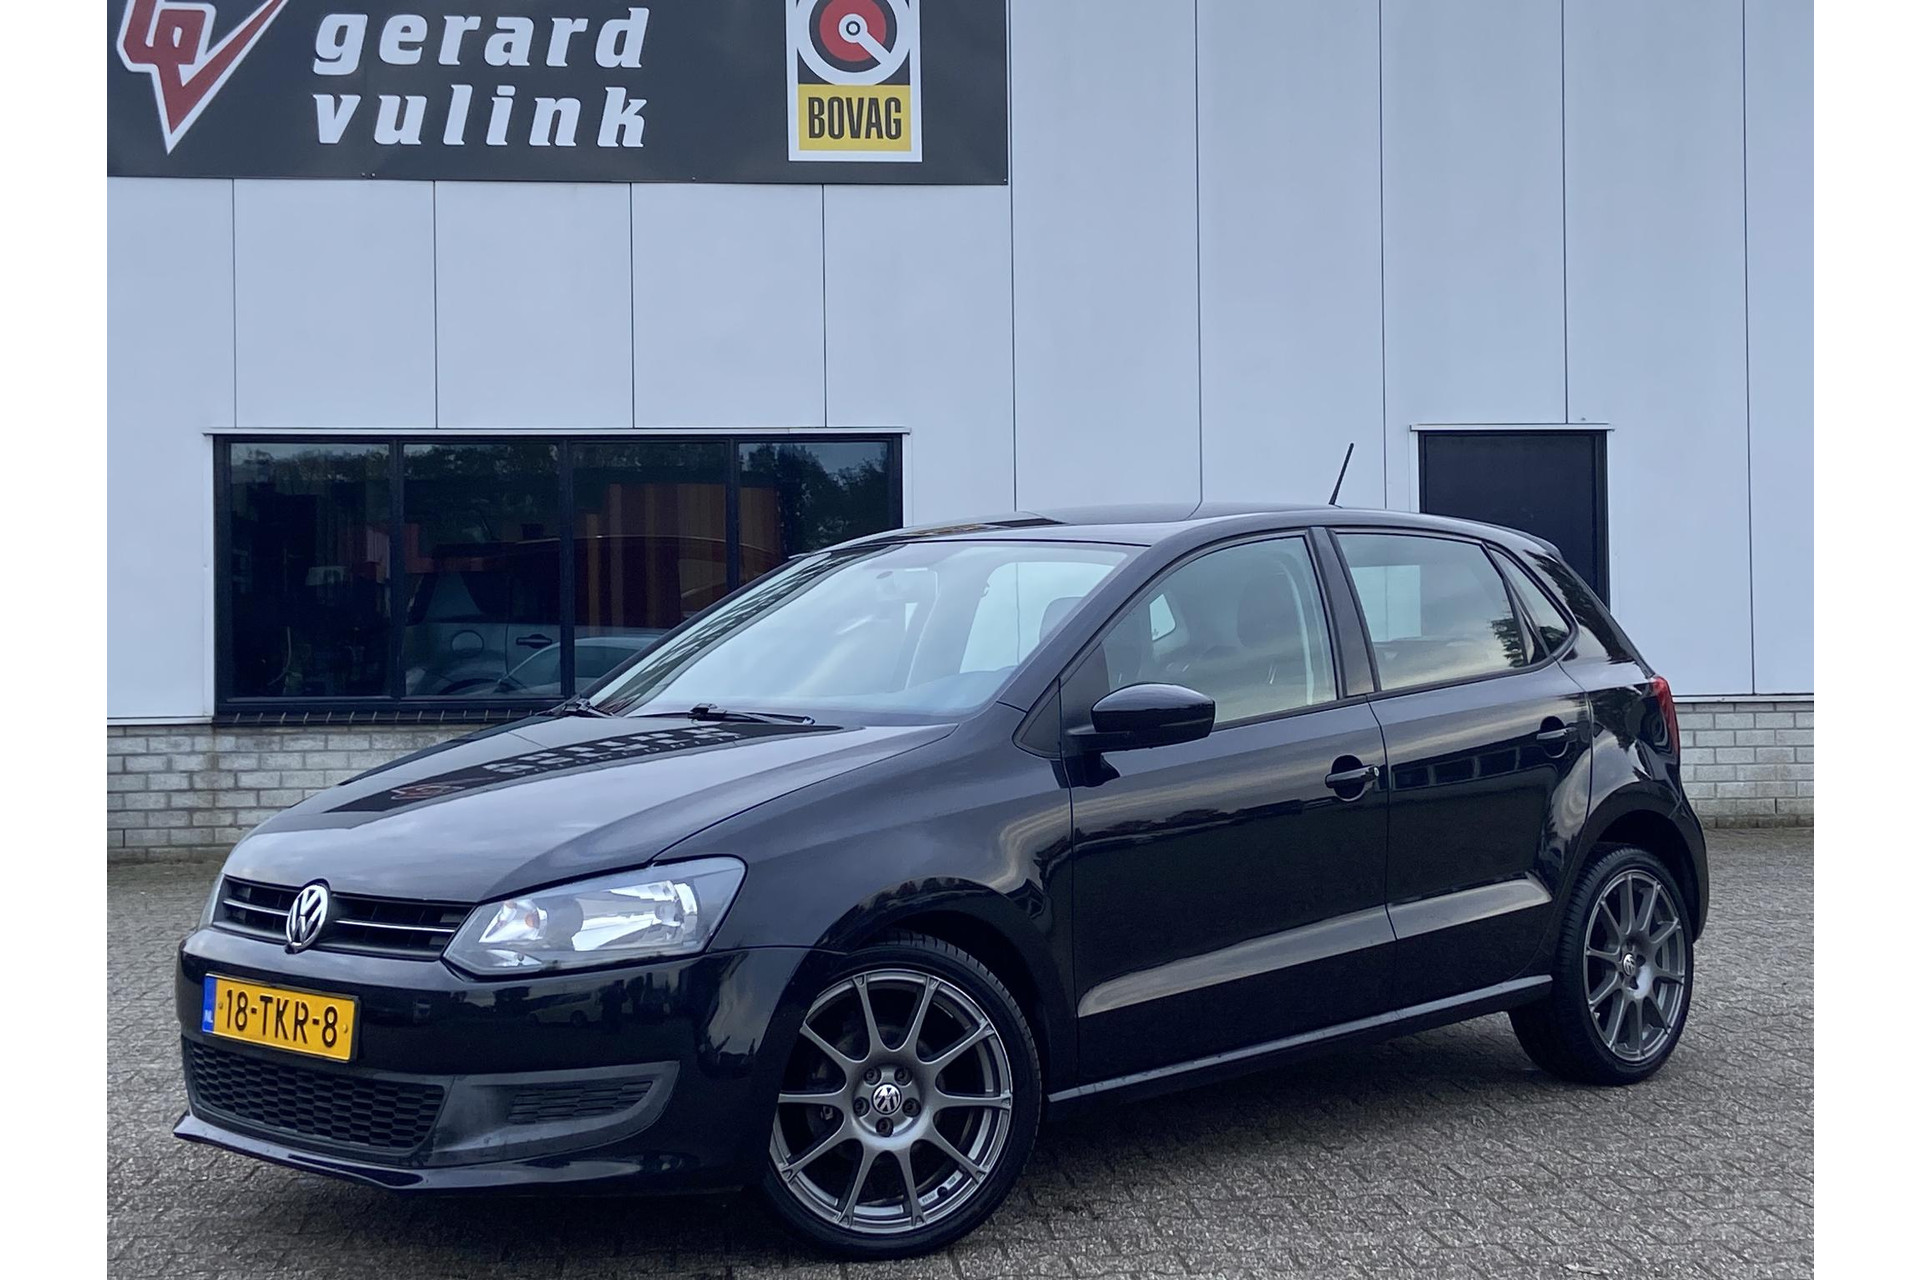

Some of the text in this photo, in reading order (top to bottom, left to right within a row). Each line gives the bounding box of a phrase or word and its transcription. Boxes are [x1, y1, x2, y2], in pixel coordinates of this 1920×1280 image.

[313, 7, 650, 76] gerard
[312, 84, 647, 148] vulink
[808, 96, 902, 140] BOVAG
[226, 989, 338, 1048] 18-TKR-8
